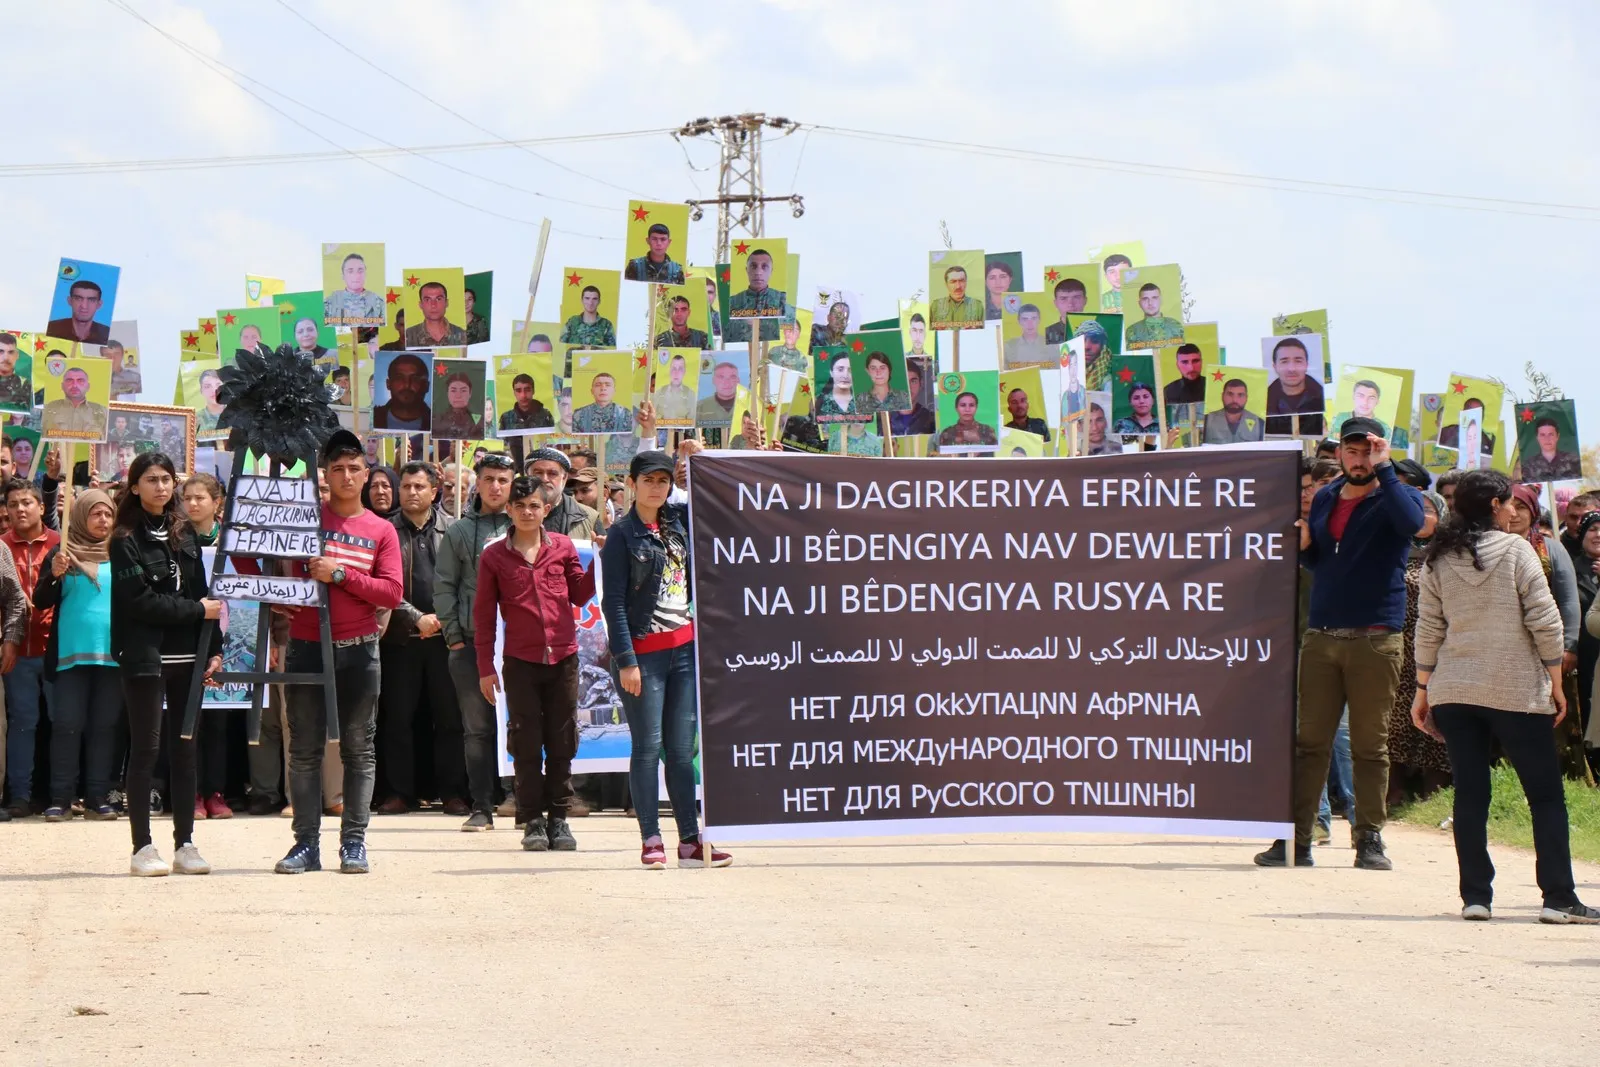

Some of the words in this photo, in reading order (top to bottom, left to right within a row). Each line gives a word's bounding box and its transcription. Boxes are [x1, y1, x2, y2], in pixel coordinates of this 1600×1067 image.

[738, 483, 789, 510] NA
[799, 483, 821, 510] JI
[837, 479, 1069, 509] DAGIRKERIYA
[1083, 472, 1201, 507] EFRÎNÊ
[1216, 479, 1255, 507] RE
[302, 535, 317, 554] RE
[714, 537, 760, 564] NA
[770, 536, 790, 563] JI
[805, 528, 992, 562] BÊDENGIYA
[1005, 532, 1077, 559] NAV
[1090, 526, 1232, 559] DEWLETÎ
[1245, 533, 1283, 560] RE
[216, 576, 250, 595] عفرين
[299, 584, 314, 601] لا
[744, 586, 794, 616] NA
[804, 585, 826, 614] JI
[842, 577, 1041, 613] BÊDENGIYA
[1055, 582, 1170, 610] RUSYA
[1184, 583, 1224, 611] RE
[726, 641, 801, 672] الروسي
[810, 639, 880, 663] للصمت
[889, 638, 902, 661] لا
[911, 637, 977, 666] الدولي
[987, 636, 1058, 659] للصمت
[1067, 636, 1081, 659] لا
[1090, 637, 1157, 665] التركي
[1166, 637, 1248, 667] للإحتلال
[1257, 639, 1270, 662] لا
[850, 694, 905, 723] ДЛЯ
[790, 741, 843, 770] ДЛЯ
[844, 785, 900, 814] ДЛЯ
